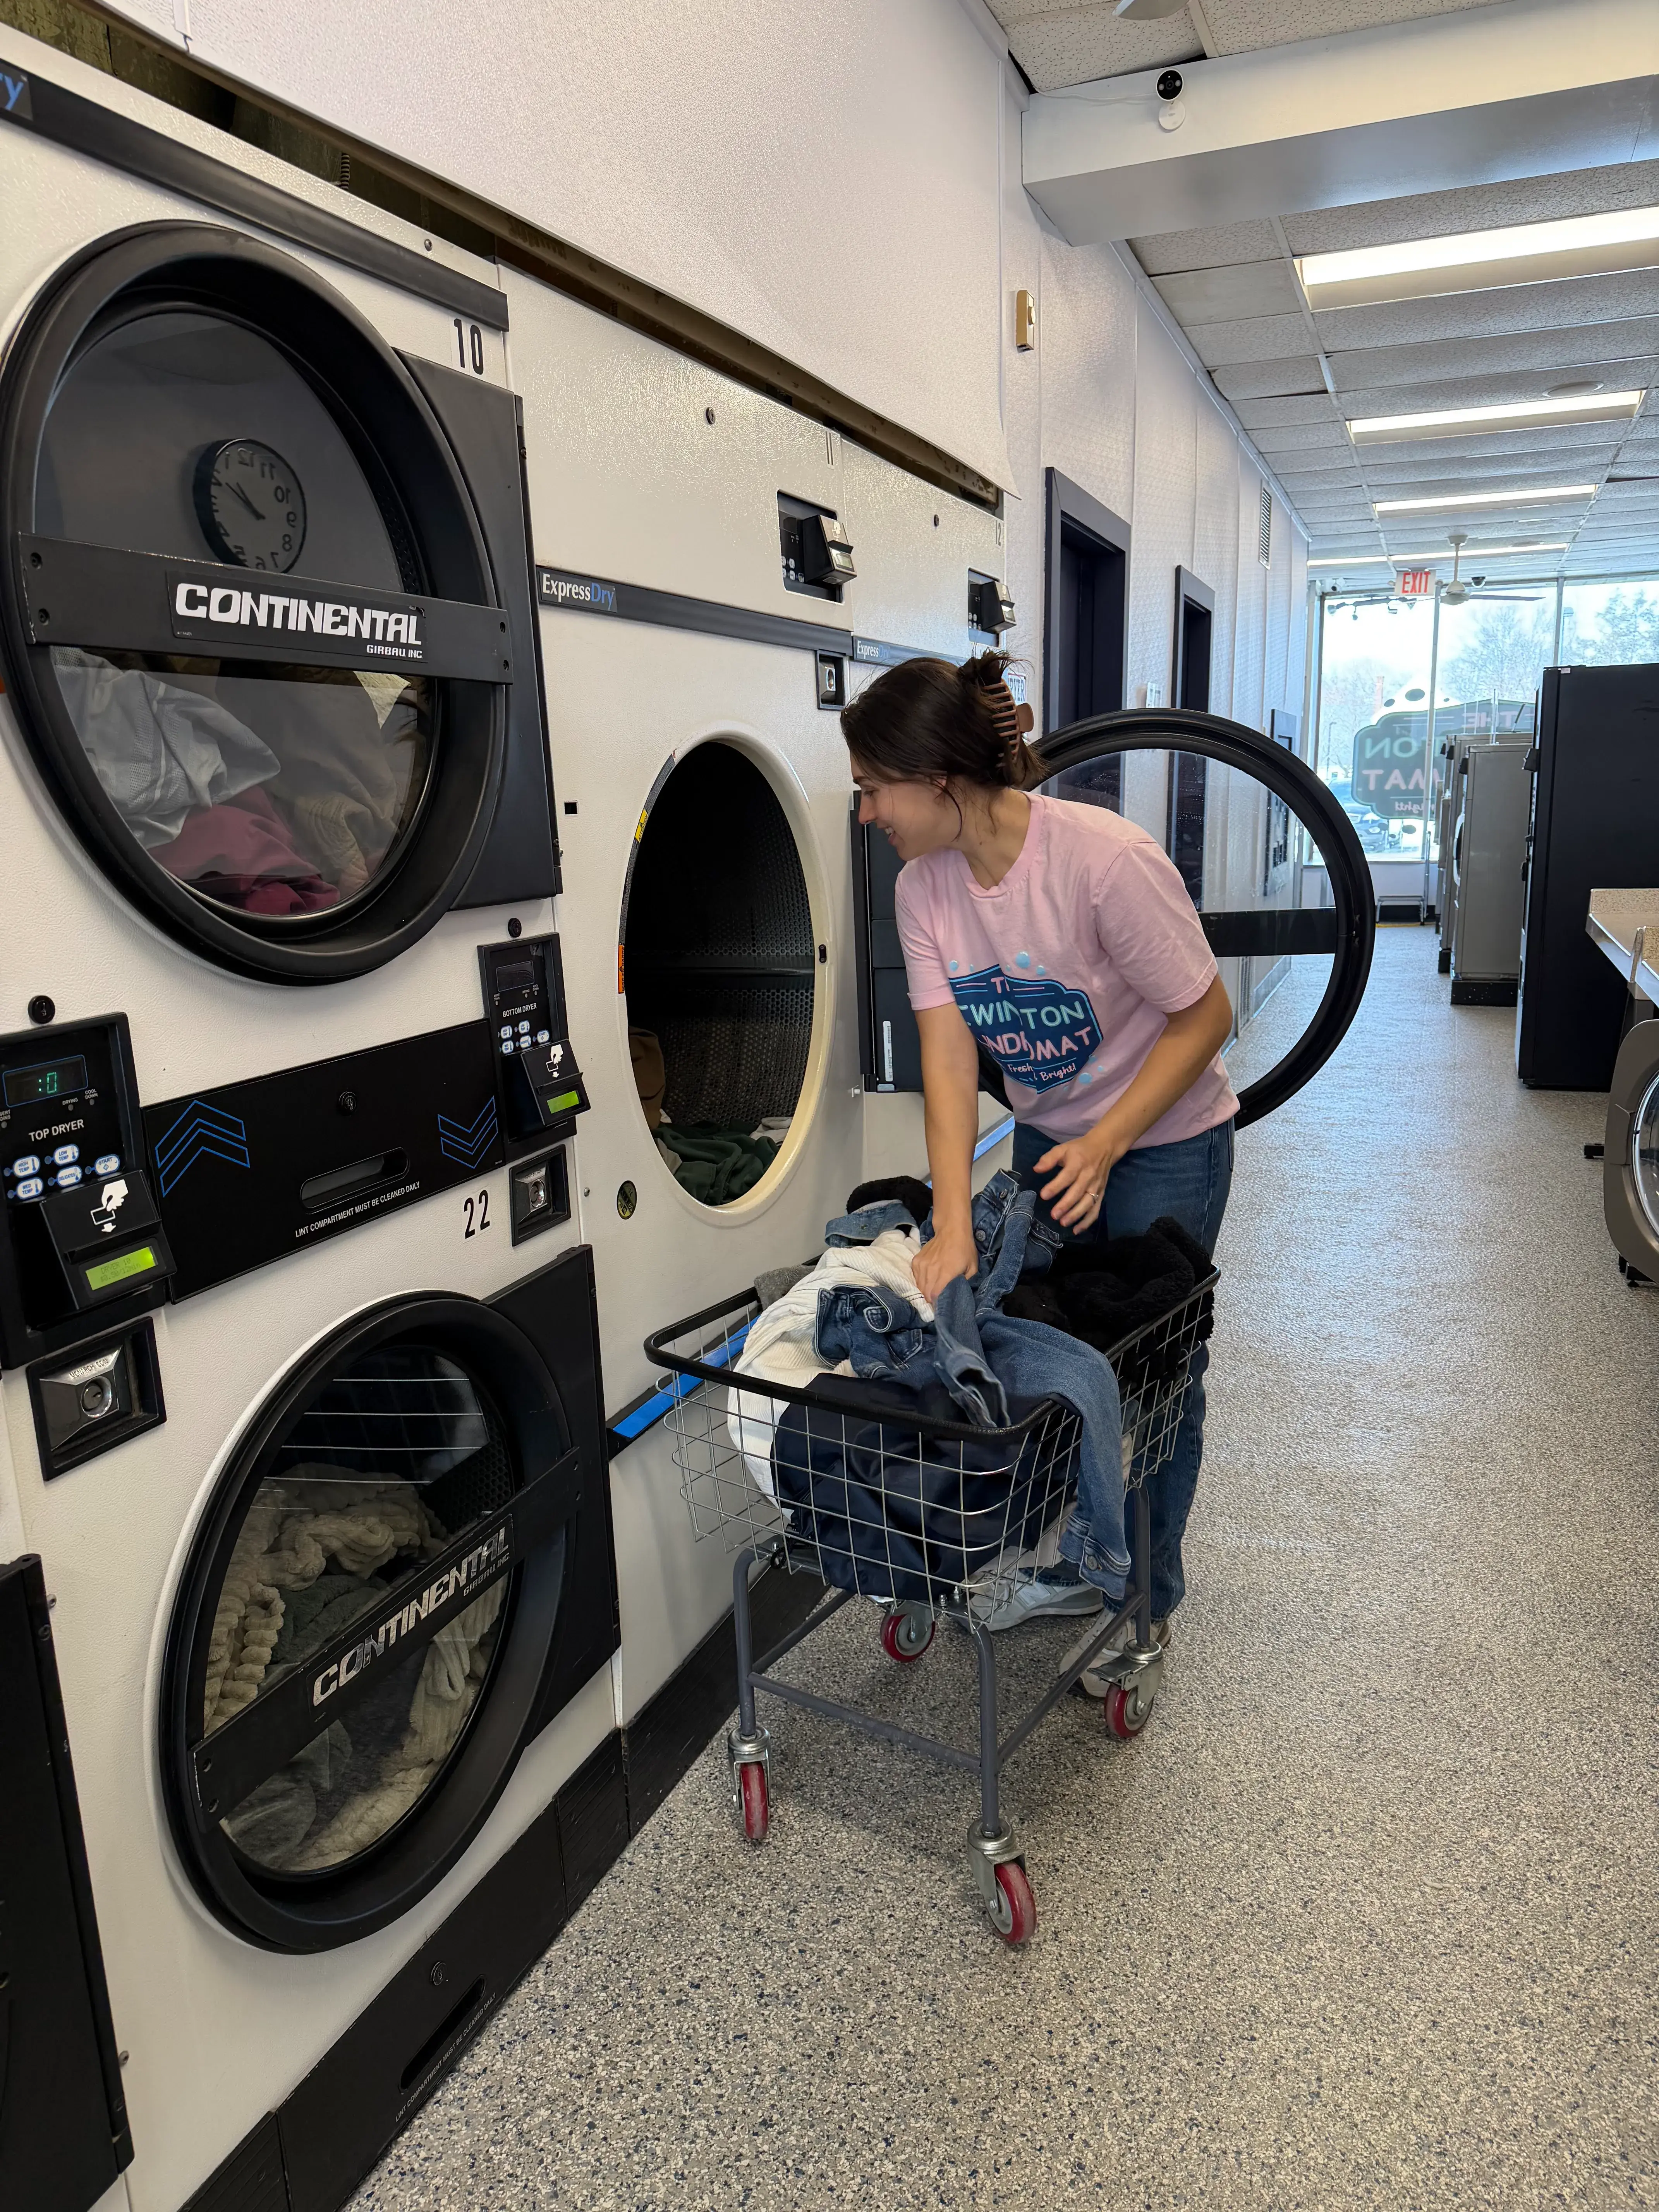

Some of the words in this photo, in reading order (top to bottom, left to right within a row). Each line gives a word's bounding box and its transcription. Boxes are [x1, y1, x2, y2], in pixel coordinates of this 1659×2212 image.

[454, 318, 484, 375] 10
[996, 520, 1001, 546] 12
[543, 573, 614, 611] ExpressDry
[1401, 572, 1431, 593] EXIT
[176, 582, 422, 646] CONTINENTAL
[366, 644, 406, 657] GIRBAU
[503, 1006, 522, 1018] BOTTOM
[522, 1003, 537, 1012] DRYER
[28, 1128, 49, 1142] TOP
[52, 1119, 84, 1136] DRYER
[295, 1226, 309, 1238] LINT
[310, 1207, 353, 1231] COMPARTMENT
[355, 1201, 370, 1213] MUST
[371, 1197, 380, 1207] BE
[380, 1187, 405, 1203] CLEANED
[406, 1181, 420, 1193] DAILY
[464, 1190, 490, 1239] 22
[101, 1262, 120, 1274] DRYER
[464, 1563, 496, 1596] GIRBAU
[313, 1527, 509, 1707] CONTINENTAL
[395, 2104, 407, 2123] LINT
[407, 2059, 442, 2107] COMPARTMENT
[443, 2042, 456, 2063] MUST
[456, 2034, 463, 2046] BE
[463, 2008, 484, 2037] CLEANED
[483, 1992, 496, 2011] DAILY
